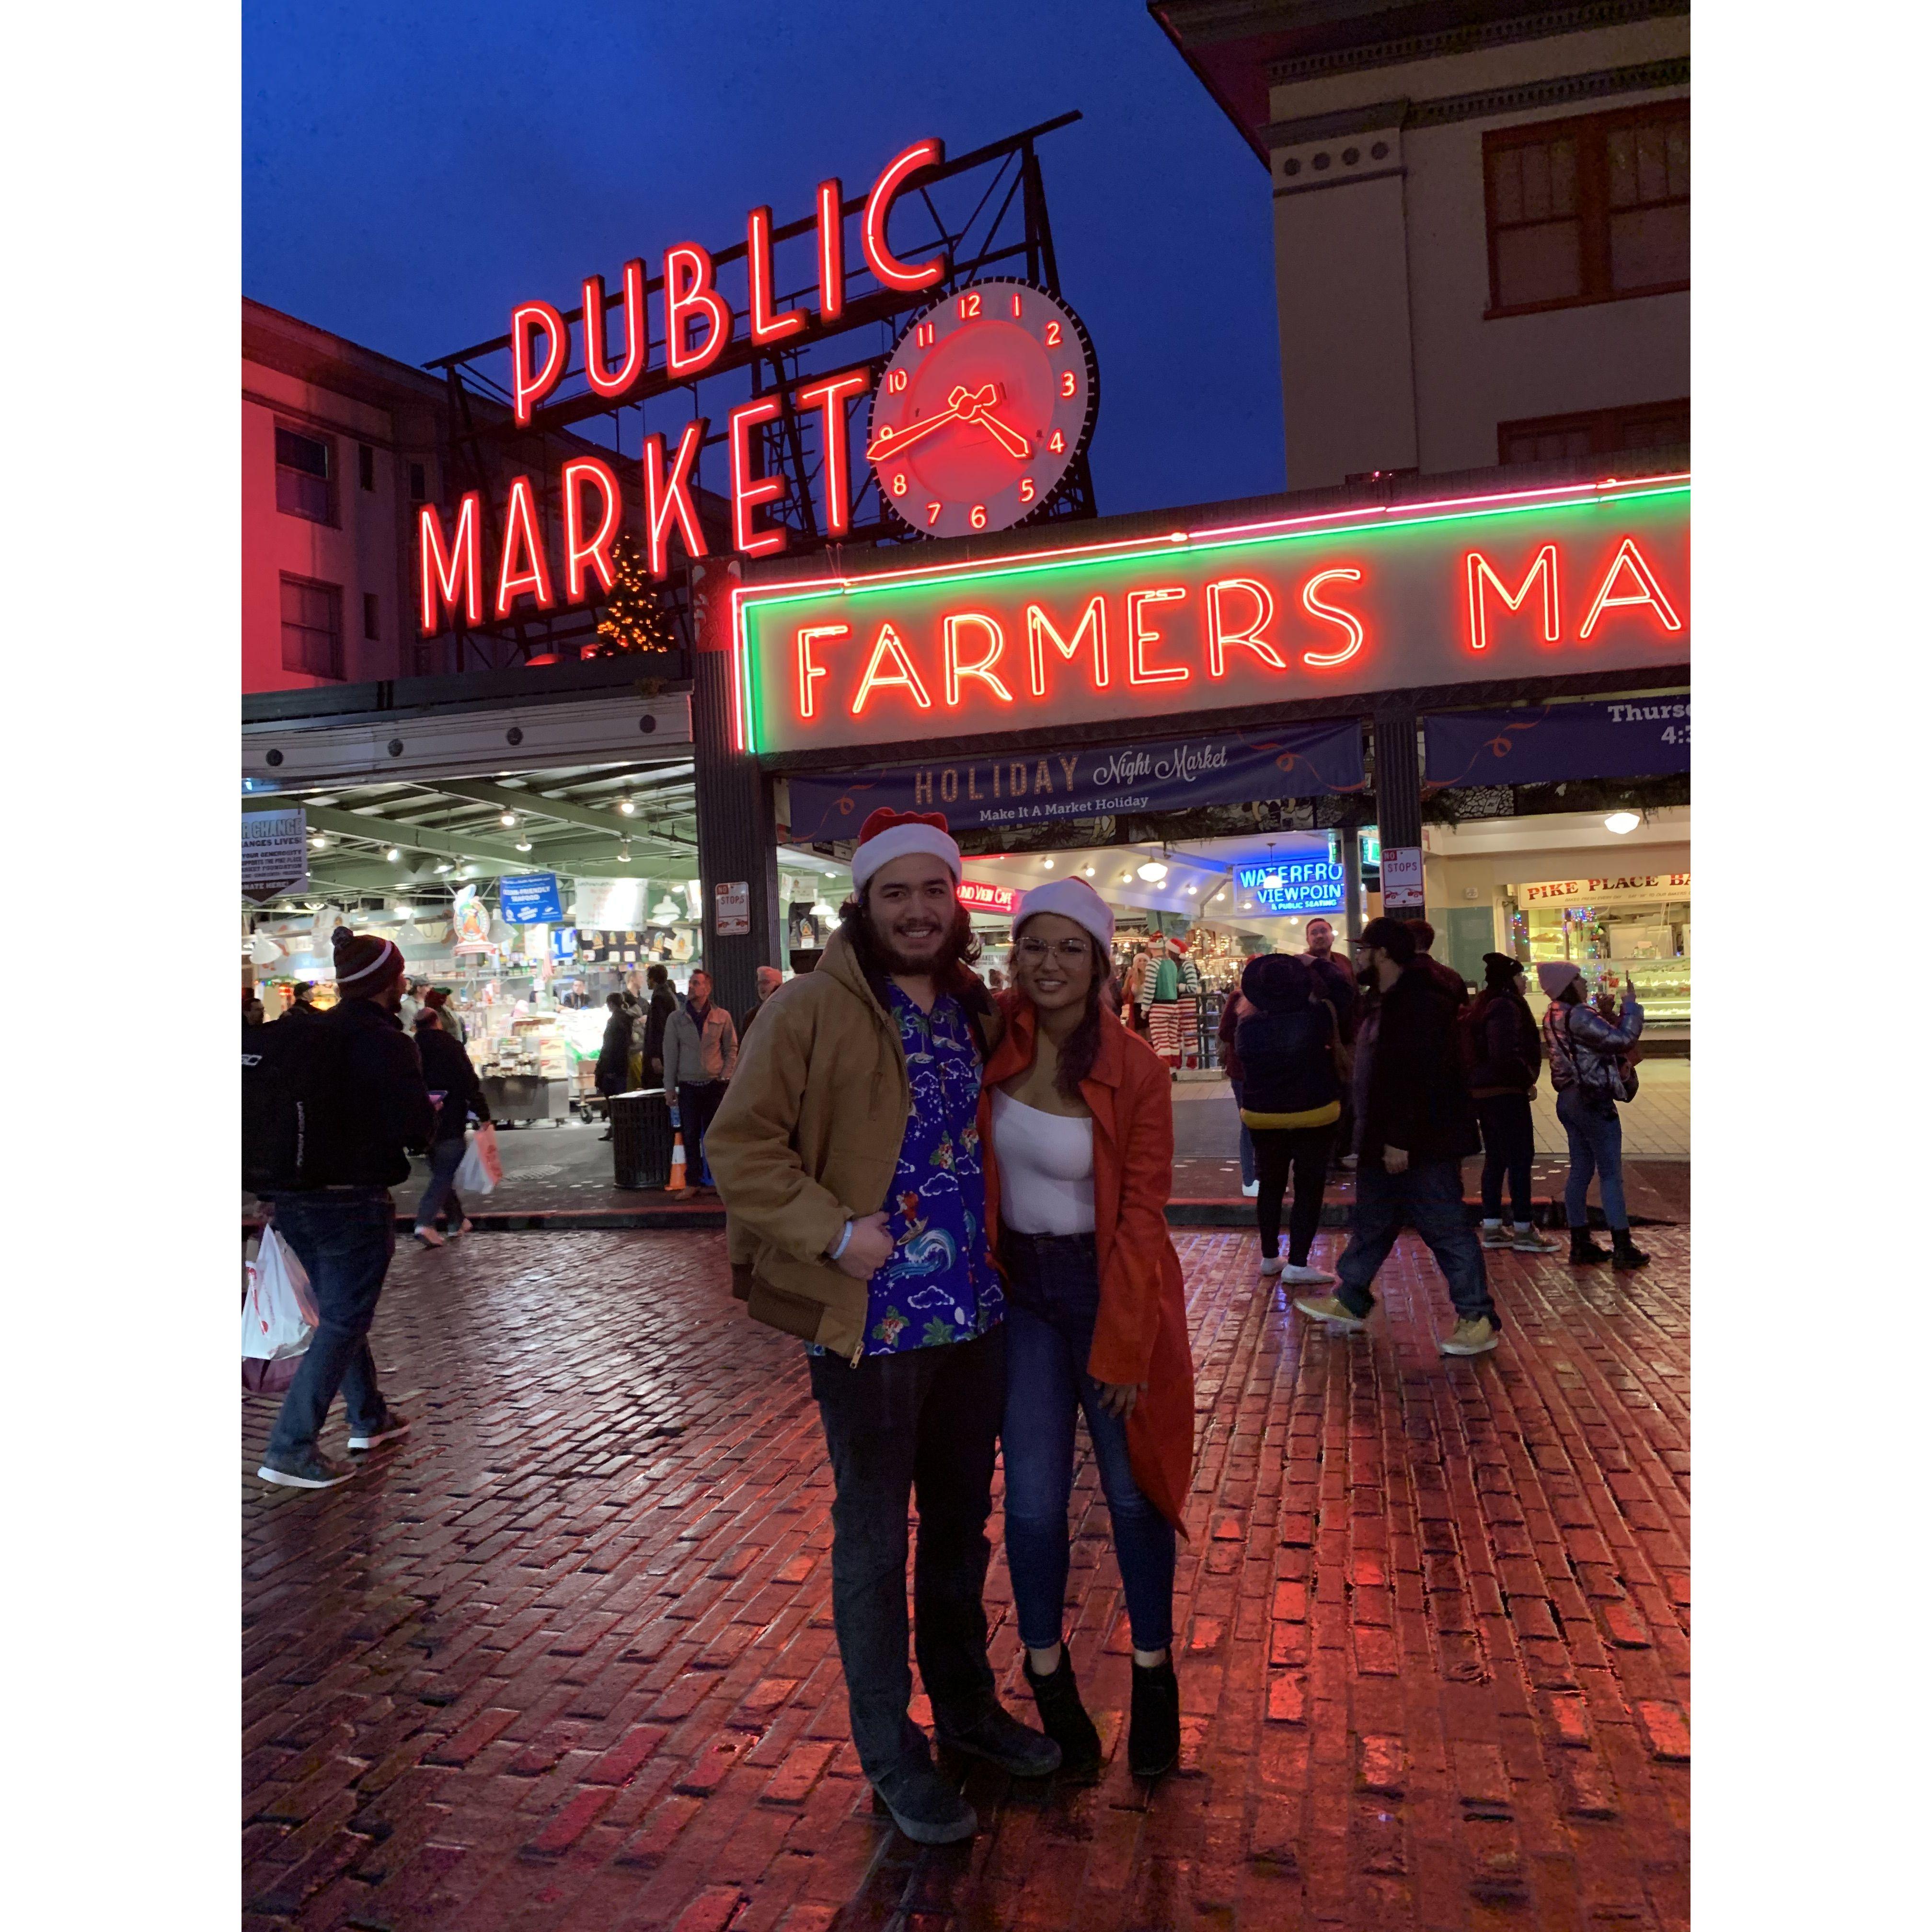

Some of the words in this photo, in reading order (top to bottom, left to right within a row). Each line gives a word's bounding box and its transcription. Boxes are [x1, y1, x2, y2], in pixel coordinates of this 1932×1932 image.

[511, 137, 945, 428] PUBLIC
[961, 294, 981, 318] 12
[919, 323, 934, 346] 11
[1047, 322, 1061, 345] 2
[888, 369, 908, 394] 10
[1061, 372, 1076, 396] 3
[1050, 431, 1065, 453] 4
[893, 474, 907, 495] 8
[1020, 479, 1034, 502] 5
[419, 367, 870, 638] MARKET
[928, 503, 942, 525] 7
[970, 506, 986, 528] 6
[797, 568, 1364, 718] FARMERS
[1467, 538, 1682, 649] MA
[915, 755, 1079, 805] HOLIDAY
[1093, 751, 1151, 785] Night
[1154, 745, 1228, 782] Market
[979, 810, 1015, 822] Make
[1018, 806, 1029, 817] It
[1032, 806, 1042, 816] A
[1045, 801, 1092, 816] Market
[1095, 795, 1149, 811] Holiday
[252, 817, 302, 838] CHANGE
[1388, 862, 1417, 873] STOPS
[1527, 882, 1579, 900] PIKE
[1588, 876, 1659, 892] PLACE
[721, 895, 745, 905] STOPS
[1305, 899, 1337, 908] SEATING
